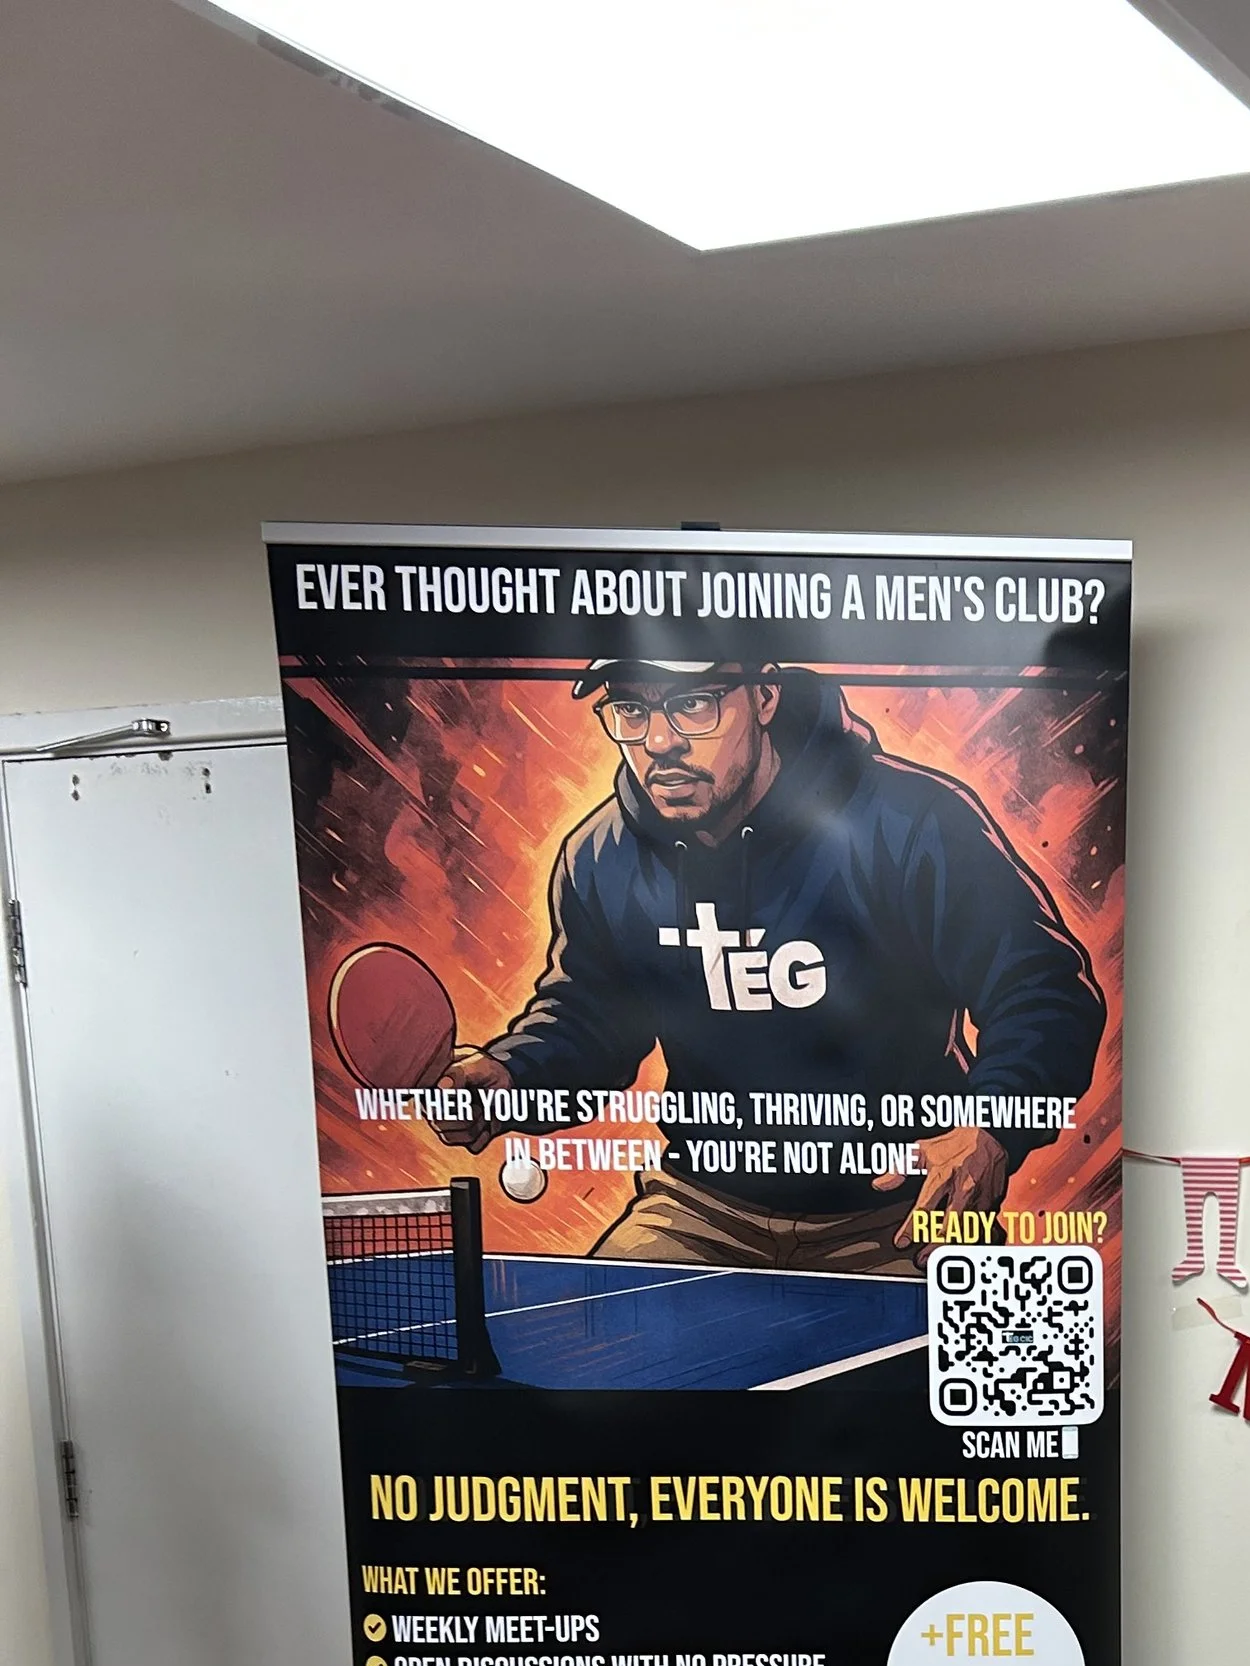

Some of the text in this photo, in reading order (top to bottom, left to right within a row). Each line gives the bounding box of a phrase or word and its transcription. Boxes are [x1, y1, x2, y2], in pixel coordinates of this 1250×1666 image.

[297, 564, 1105, 624] EVER THOUGHT ABOUT JOINING A MEN'S CLUB?
[355, 1088, 1076, 1131] WHETHER YOU'RE STRUGGLING, THRIVING, OR SOMEWHERE
[505, 1138, 535, 1171] IN
[538, 1139, 662, 1172] BETWEEN
[689, 1140, 776, 1172] YOU'RE
[784, 1142, 833, 1173] NOT
[840, 1141, 927, 1176] ALONE.
[912, 1210, 1107, 1244] READY TO JOIN?
[963, 1431, 1058, 1458] SCAN ME
[371, 1475, 1089, 1528] NO JUDGMENT, EVERYONE IS WELCOME.
[362, 1566, 545, 1595] WHAT WE OFFER:
[392, 1615, 599, 1642] WEEKLY MEET-UPS
[923, 1614, 1033, 1656] +FREE
